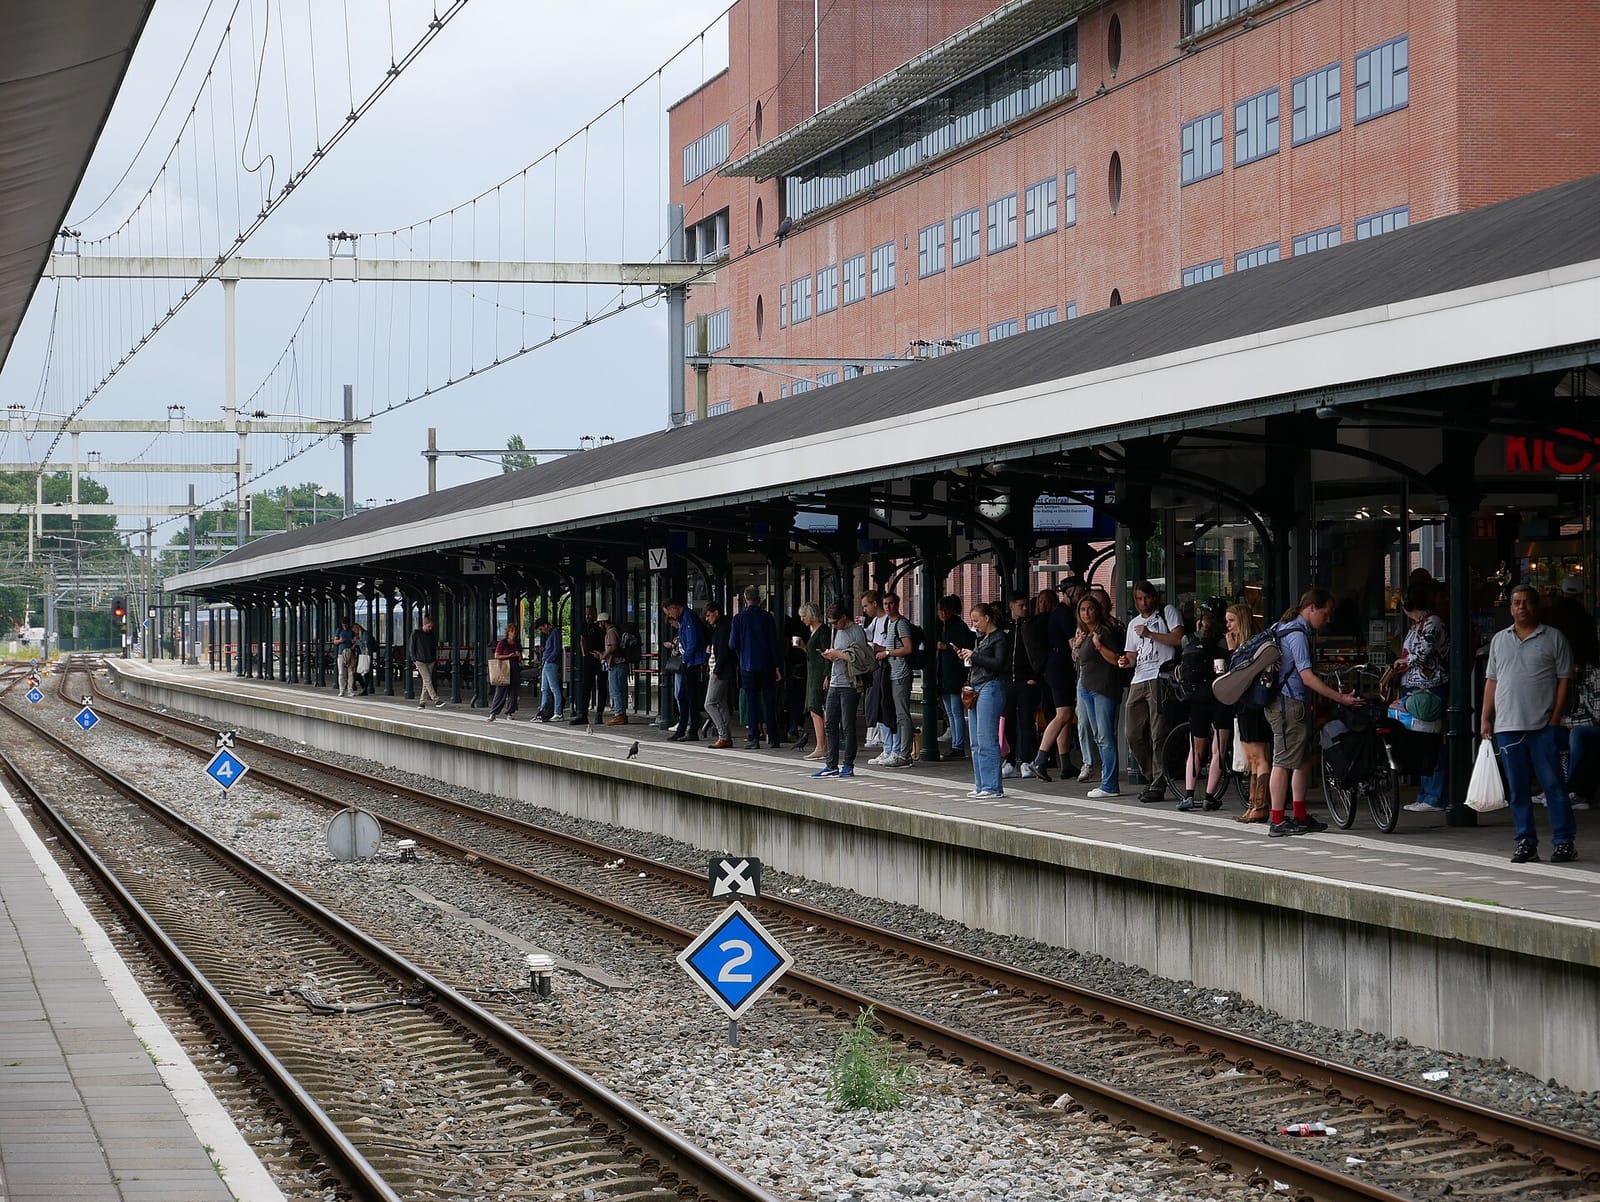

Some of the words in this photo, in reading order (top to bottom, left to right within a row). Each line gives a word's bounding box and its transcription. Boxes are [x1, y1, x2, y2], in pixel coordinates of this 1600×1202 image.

[1506, 426, 1600, 474] KIO
[217, 760, 234, 778] 4
[717, 939, 753, 983] 2
